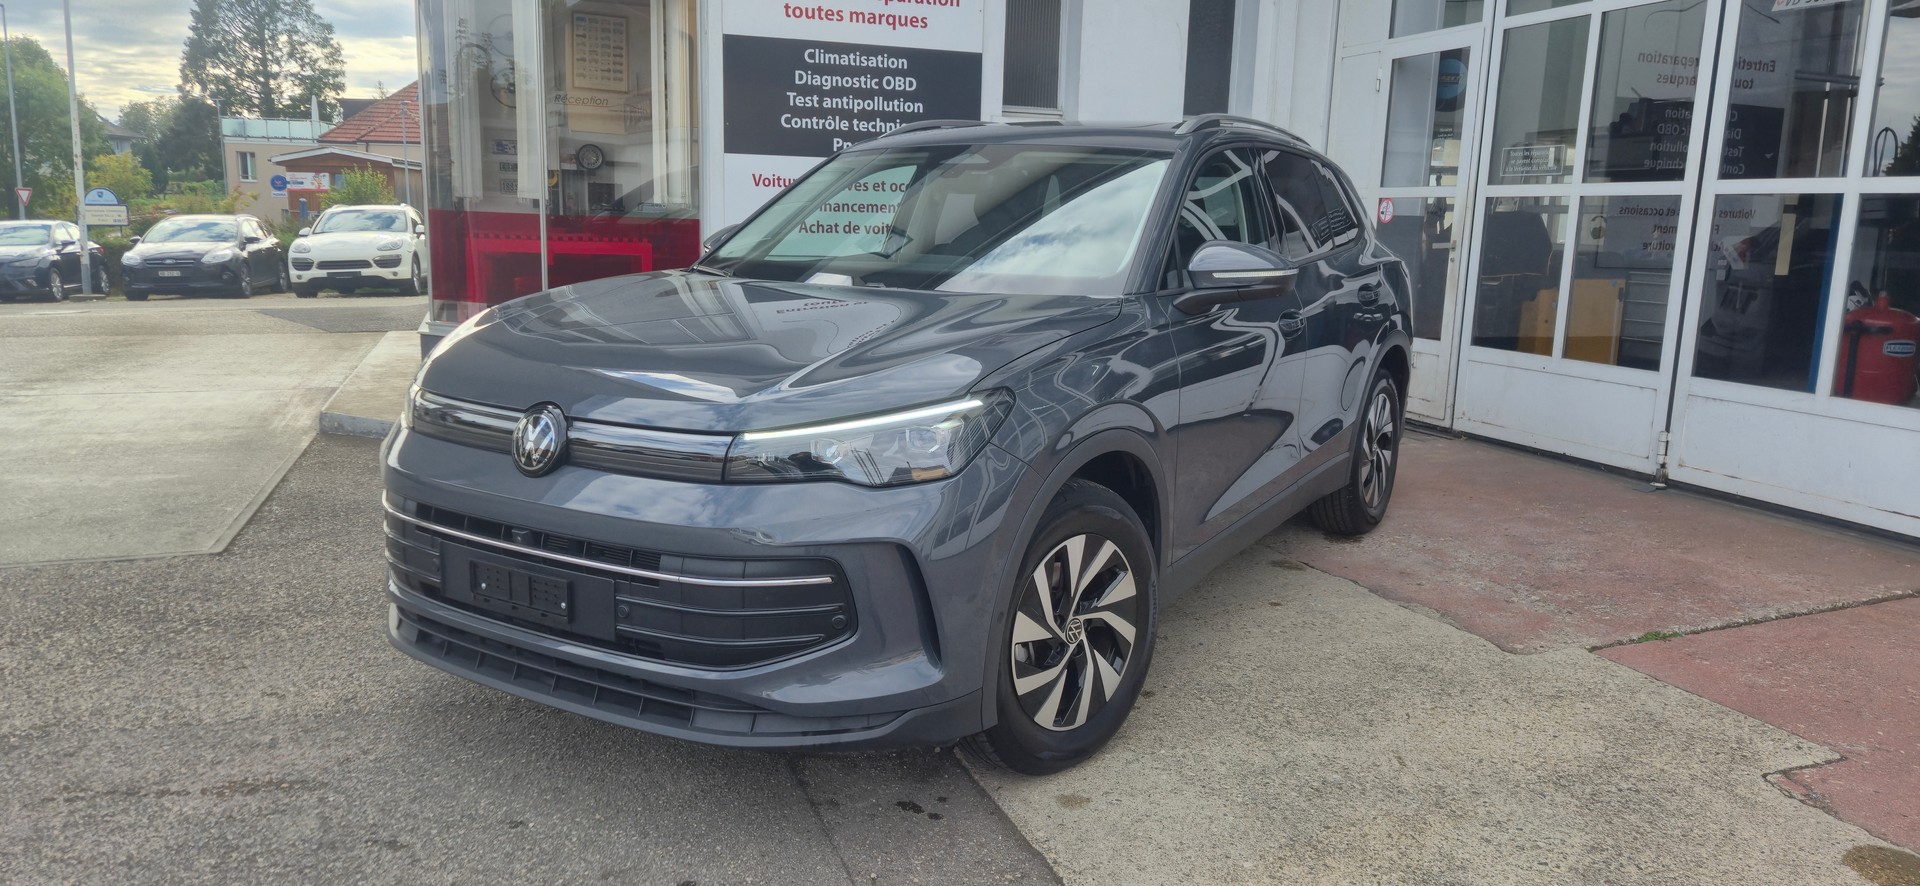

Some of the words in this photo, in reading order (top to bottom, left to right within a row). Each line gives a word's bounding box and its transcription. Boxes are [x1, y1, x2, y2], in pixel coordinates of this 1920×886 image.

[784, 3, 844, 22] toutes
[849, 10, 928, 30] marques
[804, 48, 908, 69] Climatisation
[795, 70, 879, 89] Diagnostic
[882, 76, 917, 91] OBD
[553, 94, 609, 106] Réception
[786, 92, 819, 108] Test
[822, 95, 924, 113] antipollution
[780, 113, 849, 131] Contrôle
[852, 118, 905, 133] techni
[752, 173, 796, 188] Voitu
[872, 180, 886, 192] et
[799, 220, 839, 234] Achat
[842, 220, 860, 234] de
[864, 221, 891, 235] voit
